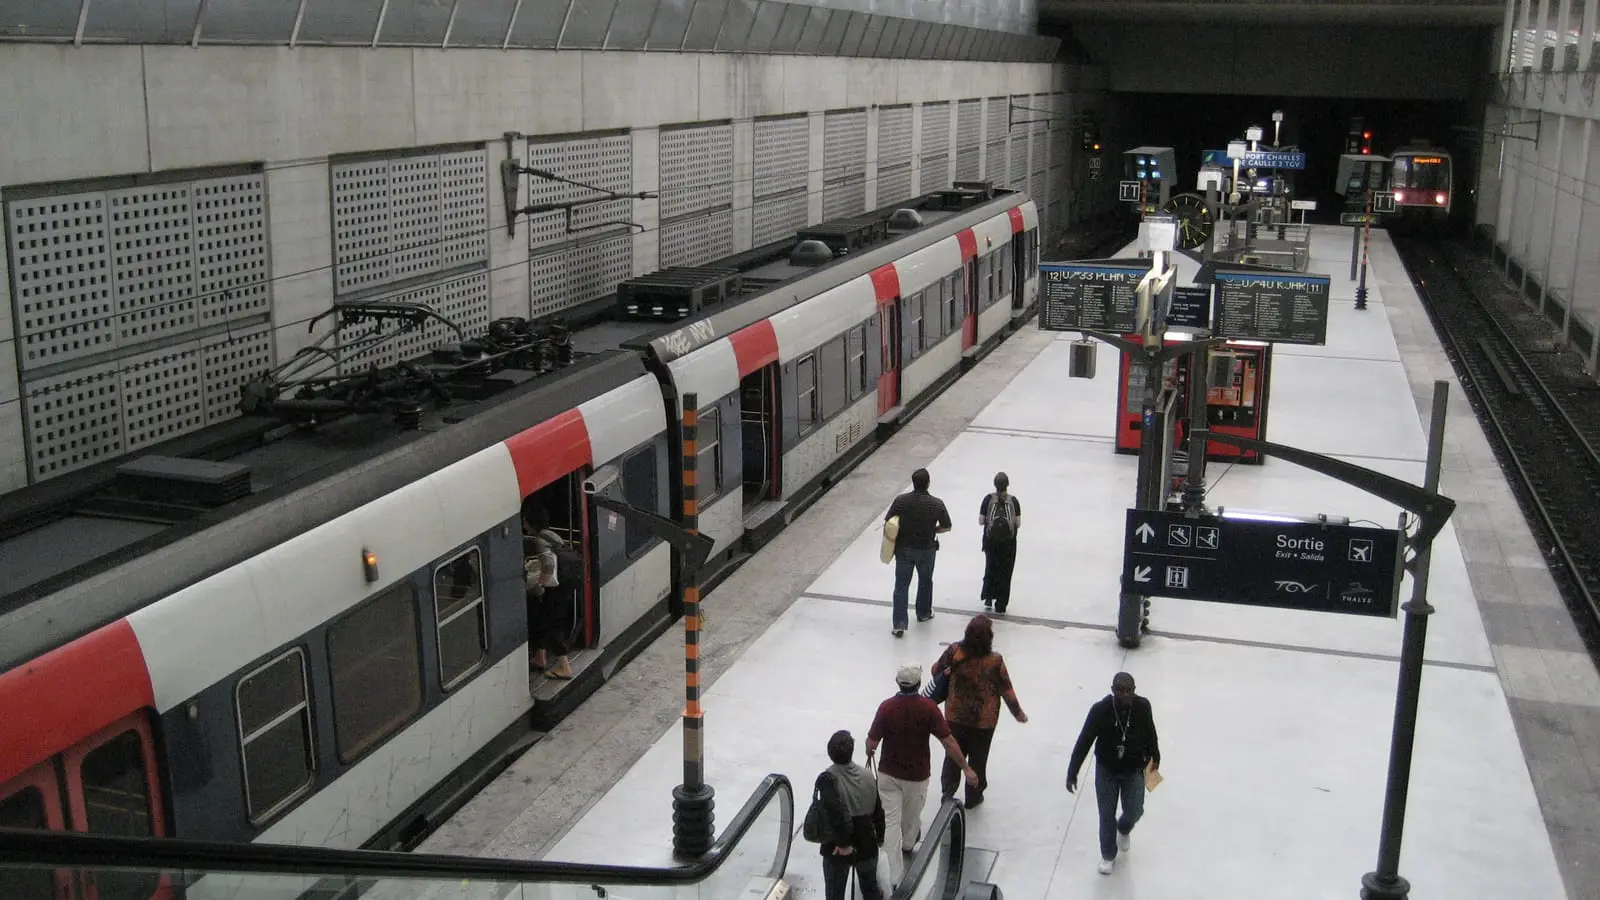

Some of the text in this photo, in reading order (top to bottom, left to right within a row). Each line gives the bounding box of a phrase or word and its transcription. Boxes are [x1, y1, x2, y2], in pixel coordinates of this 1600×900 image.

[1049, 272, 1059, 280] 12
[1276, 534, 1324, 550] Sortie
[1275, 551, 1325, 561] Exit Salida
[1274, 581, 1318, 593] TGV
